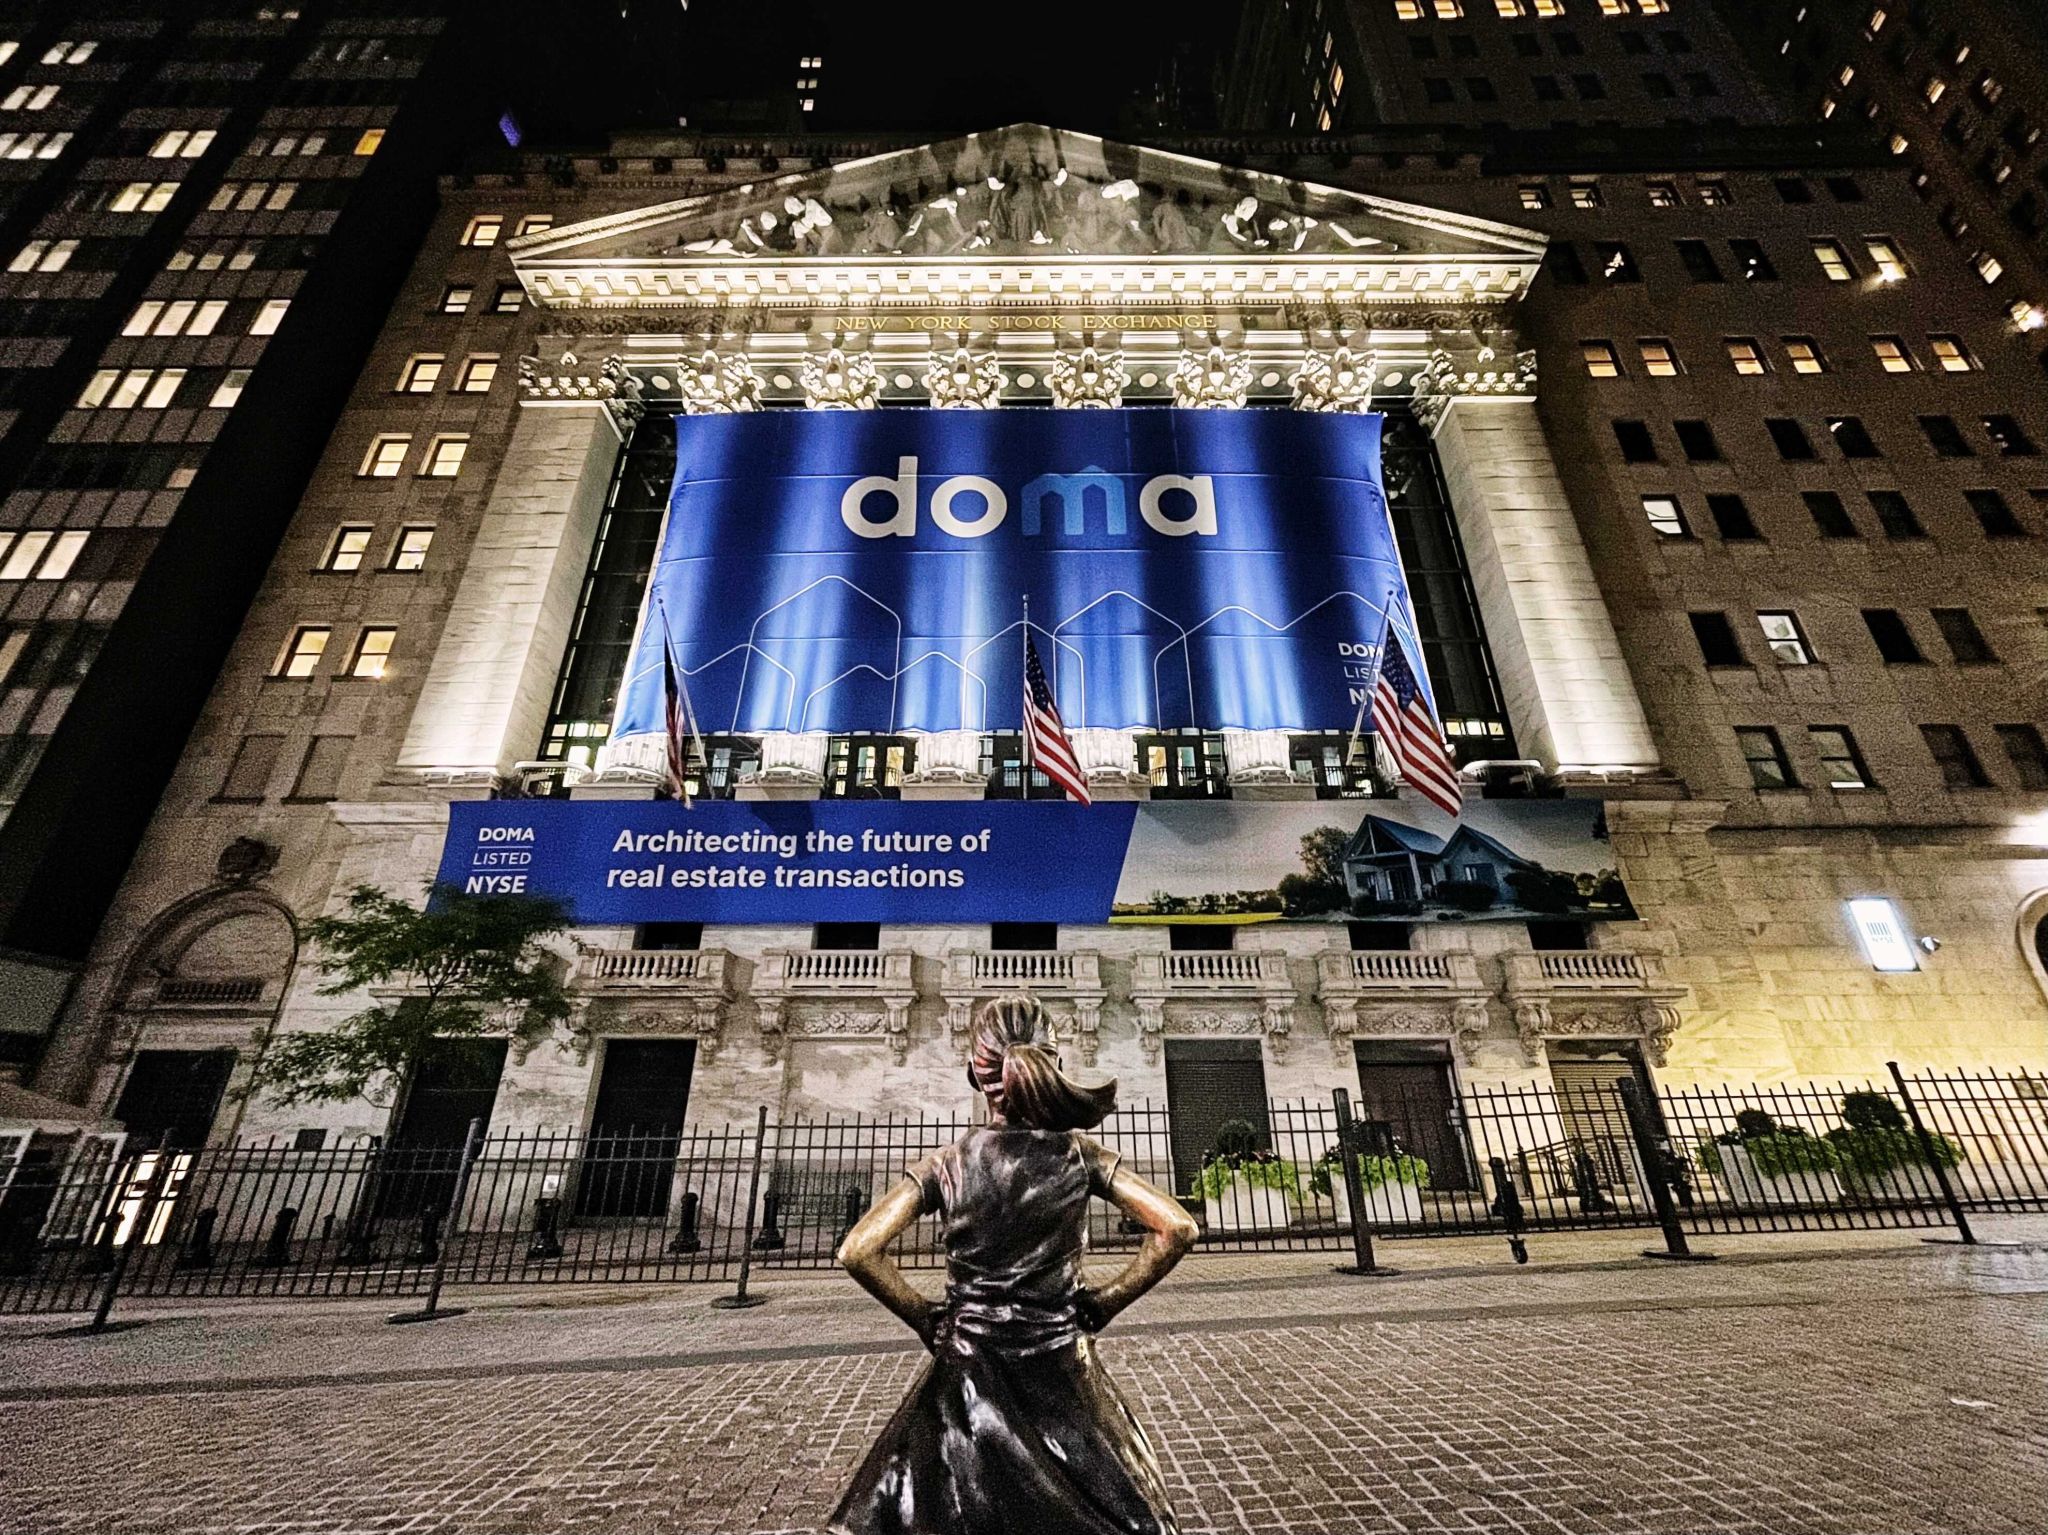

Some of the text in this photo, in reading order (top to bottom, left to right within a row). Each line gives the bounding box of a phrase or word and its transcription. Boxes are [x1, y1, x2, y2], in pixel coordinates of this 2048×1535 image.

[835, 314, 1217, 330] NEW YORK STOCK EXCHANGE
[841, 455, 1218, 539] doma
[1338, 642, 1384, 659] DOM
[1344, 666, 1380, 680] LIST
[478, 827, 535, 842] DOMA
[612, 828, 991, 858] Architecting the future of
[472, 852, 532, 865] LISTED
[607, 863, 965, 888] real estate transactions
[465, 875, 528, 894] NYSE
